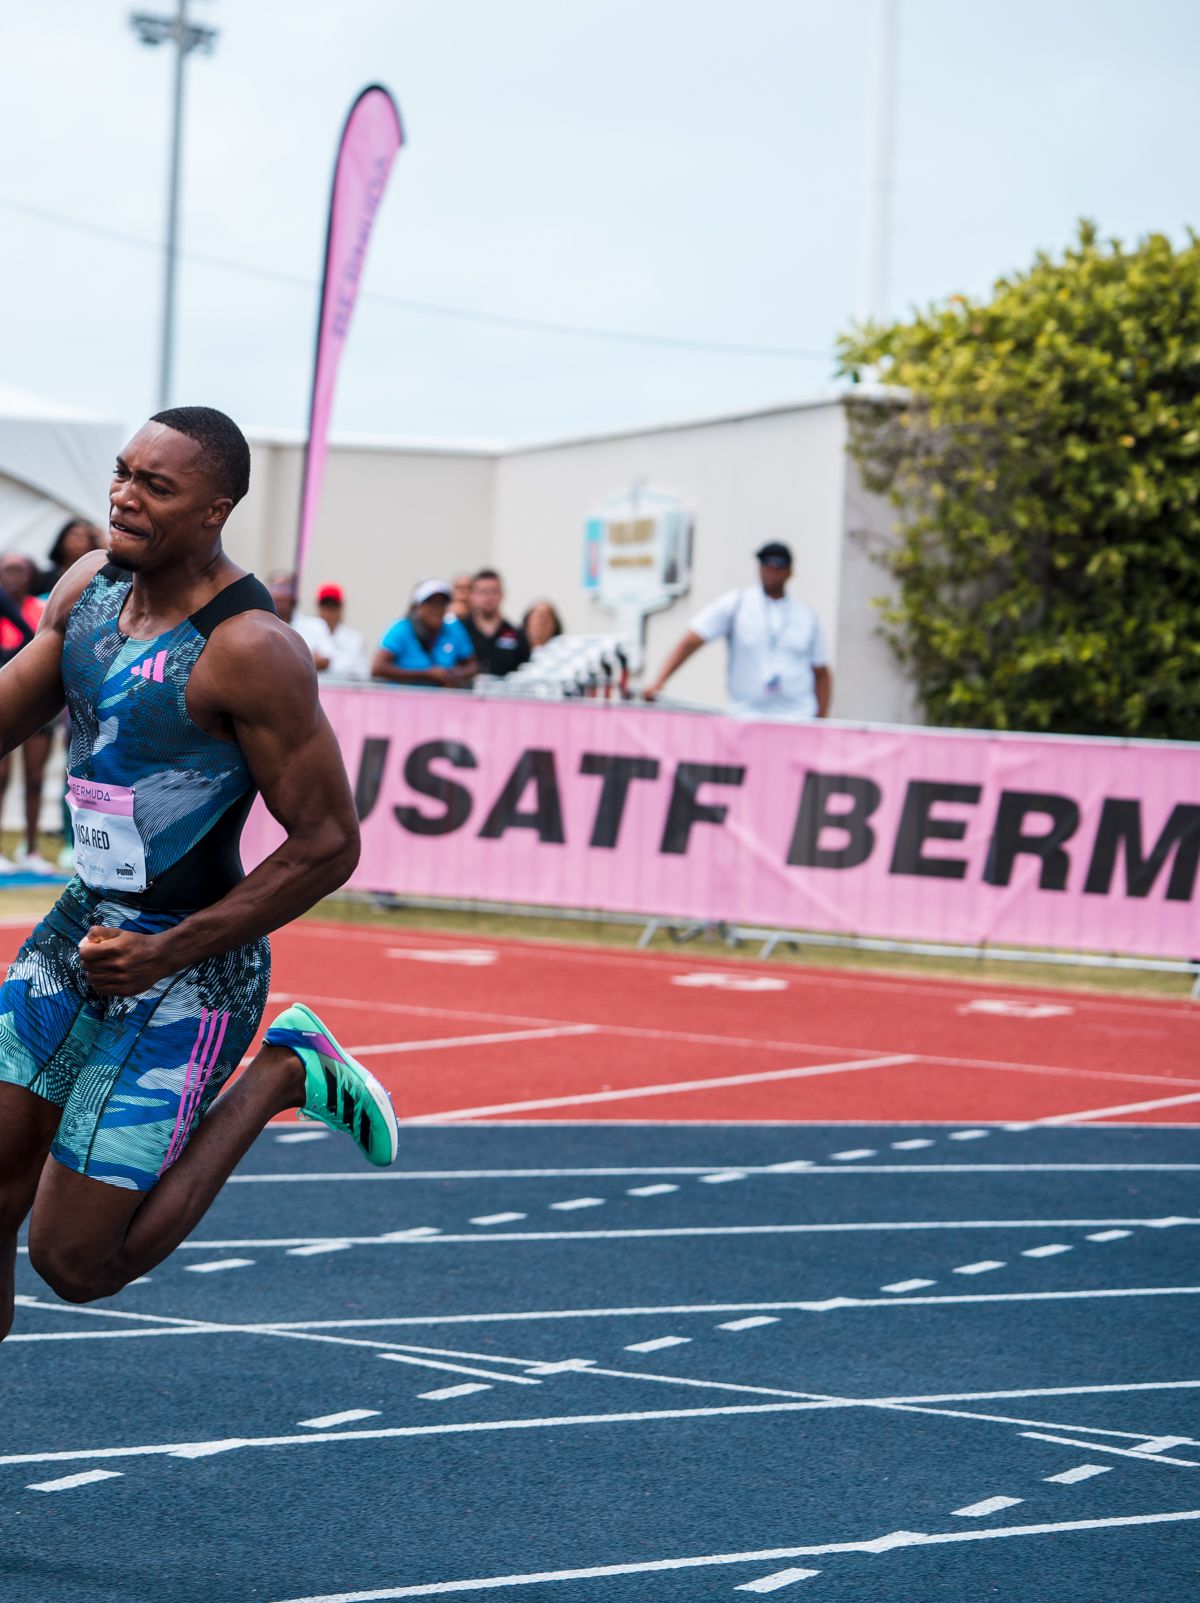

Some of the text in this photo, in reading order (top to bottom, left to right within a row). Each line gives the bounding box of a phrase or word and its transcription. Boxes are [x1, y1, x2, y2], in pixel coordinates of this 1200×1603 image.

[72, 783, 111, 801] BERMUDA
[75, 823, 110, 850] USA RED
[786, 769, 1200, 903] BERM
[116, 868, 134, 877] PUMA
